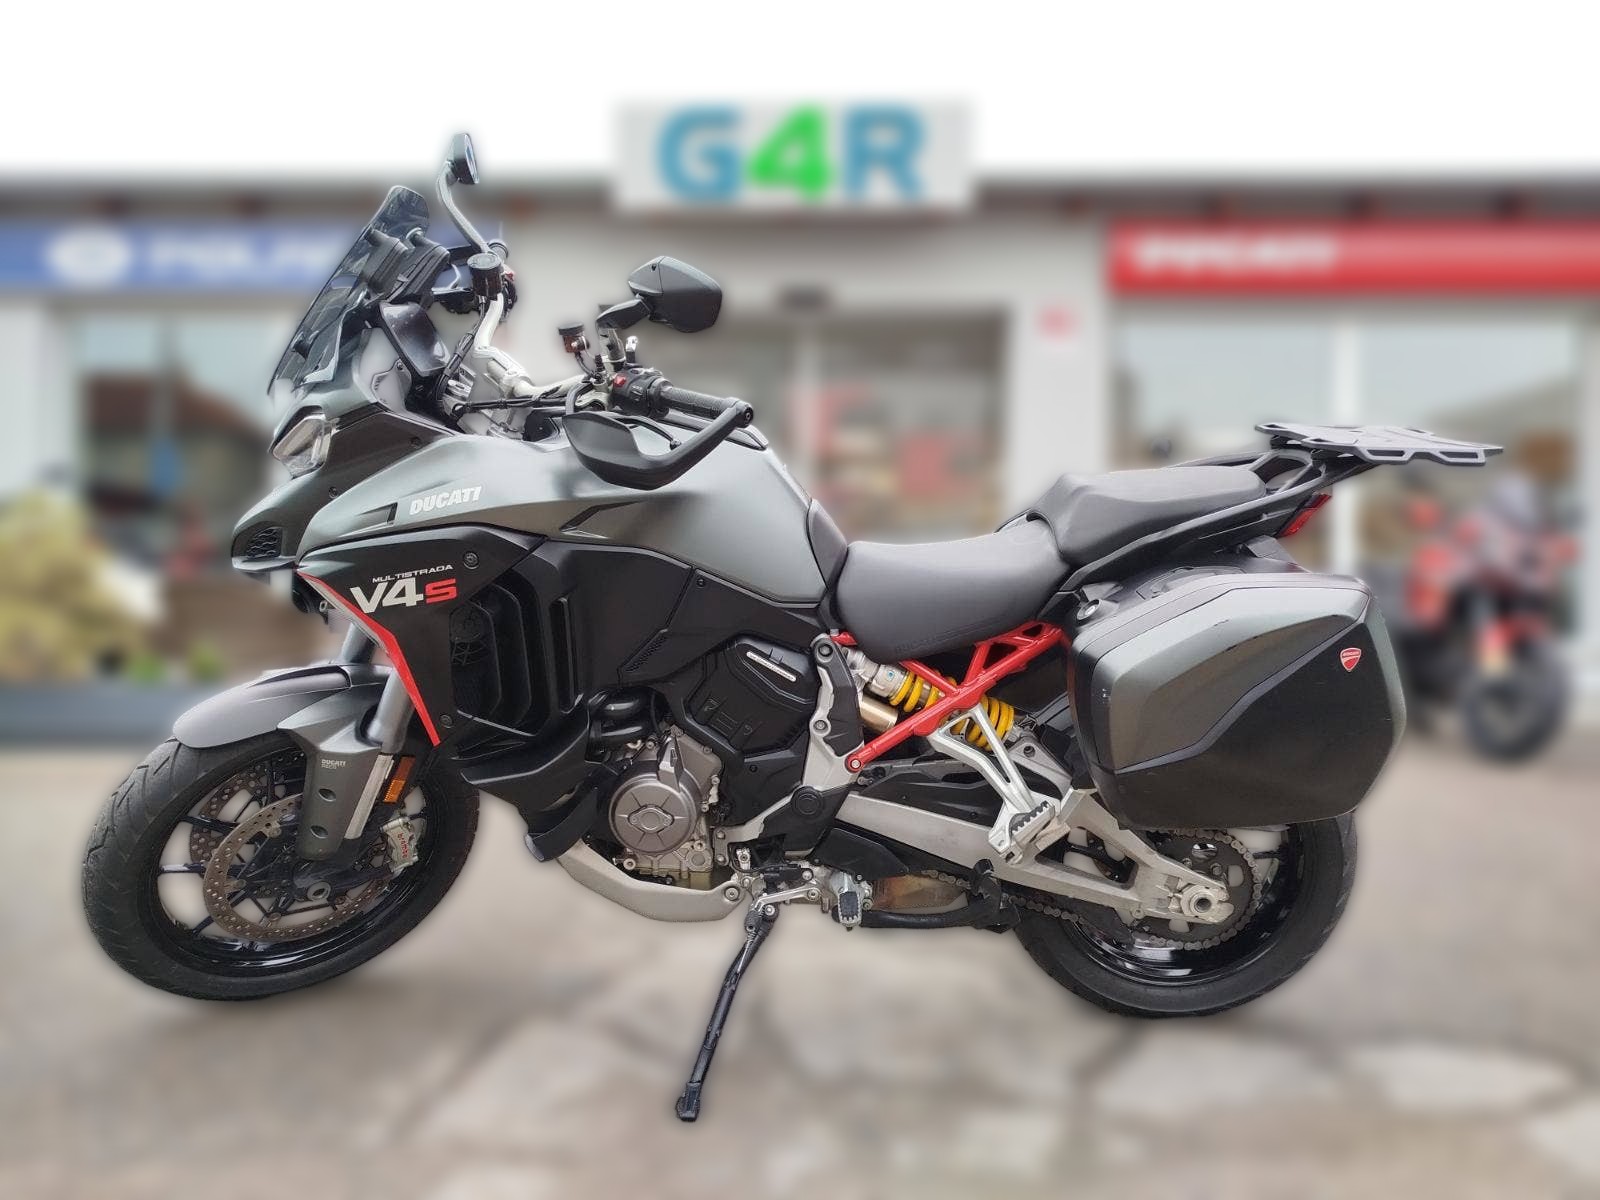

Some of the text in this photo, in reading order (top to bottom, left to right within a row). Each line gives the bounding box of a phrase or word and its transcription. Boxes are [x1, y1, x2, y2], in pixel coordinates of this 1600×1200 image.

[657, 104, 927, 202] G4R
[409, 486, 482, 515] DUCATI
[372, 564, 454, 583] MULTISTRADA
[350, 577, 458, 614] V4S
